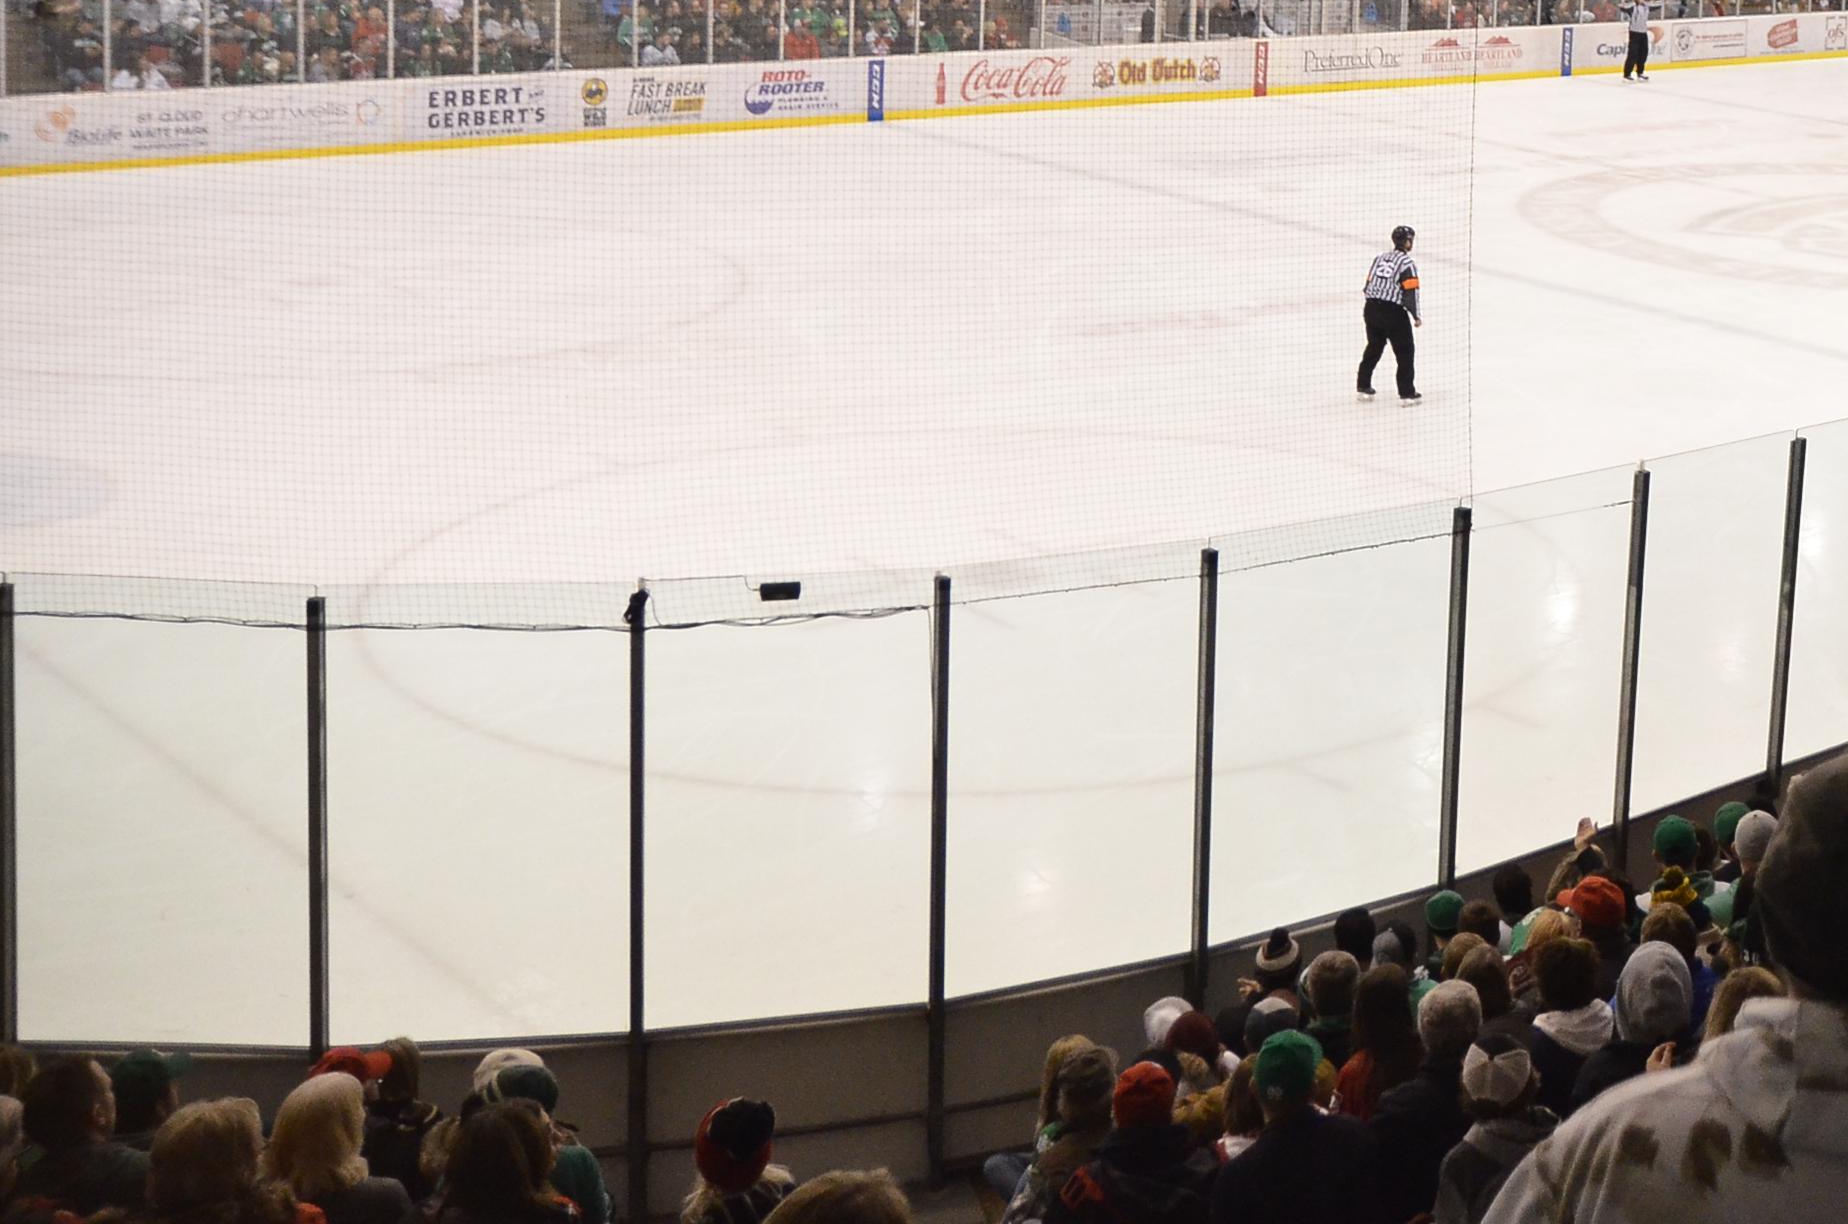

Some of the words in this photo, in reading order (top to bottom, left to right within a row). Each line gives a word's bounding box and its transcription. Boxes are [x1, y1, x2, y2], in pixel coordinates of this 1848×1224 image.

[1256, 44, 1266, 86] CCM
[1304, 46, 1402, 73] PreferredOne
[1117, 60, 1147, 85] Old
[1151, 57, 1197, 83] Dutch
[630, 82, 663, 99] FAST
[665, 81, 707, 97] BREAK
[757, 81, 825, 96] ROOTER
[871, 63, 881, 110] CCM
[428, 87, 524, 108] ERBERT
[626, 99, 673, 116] LUNCH
[428, 107, 546, 129] GERBERT'S
[1375, 261, 1395, 278] 26
